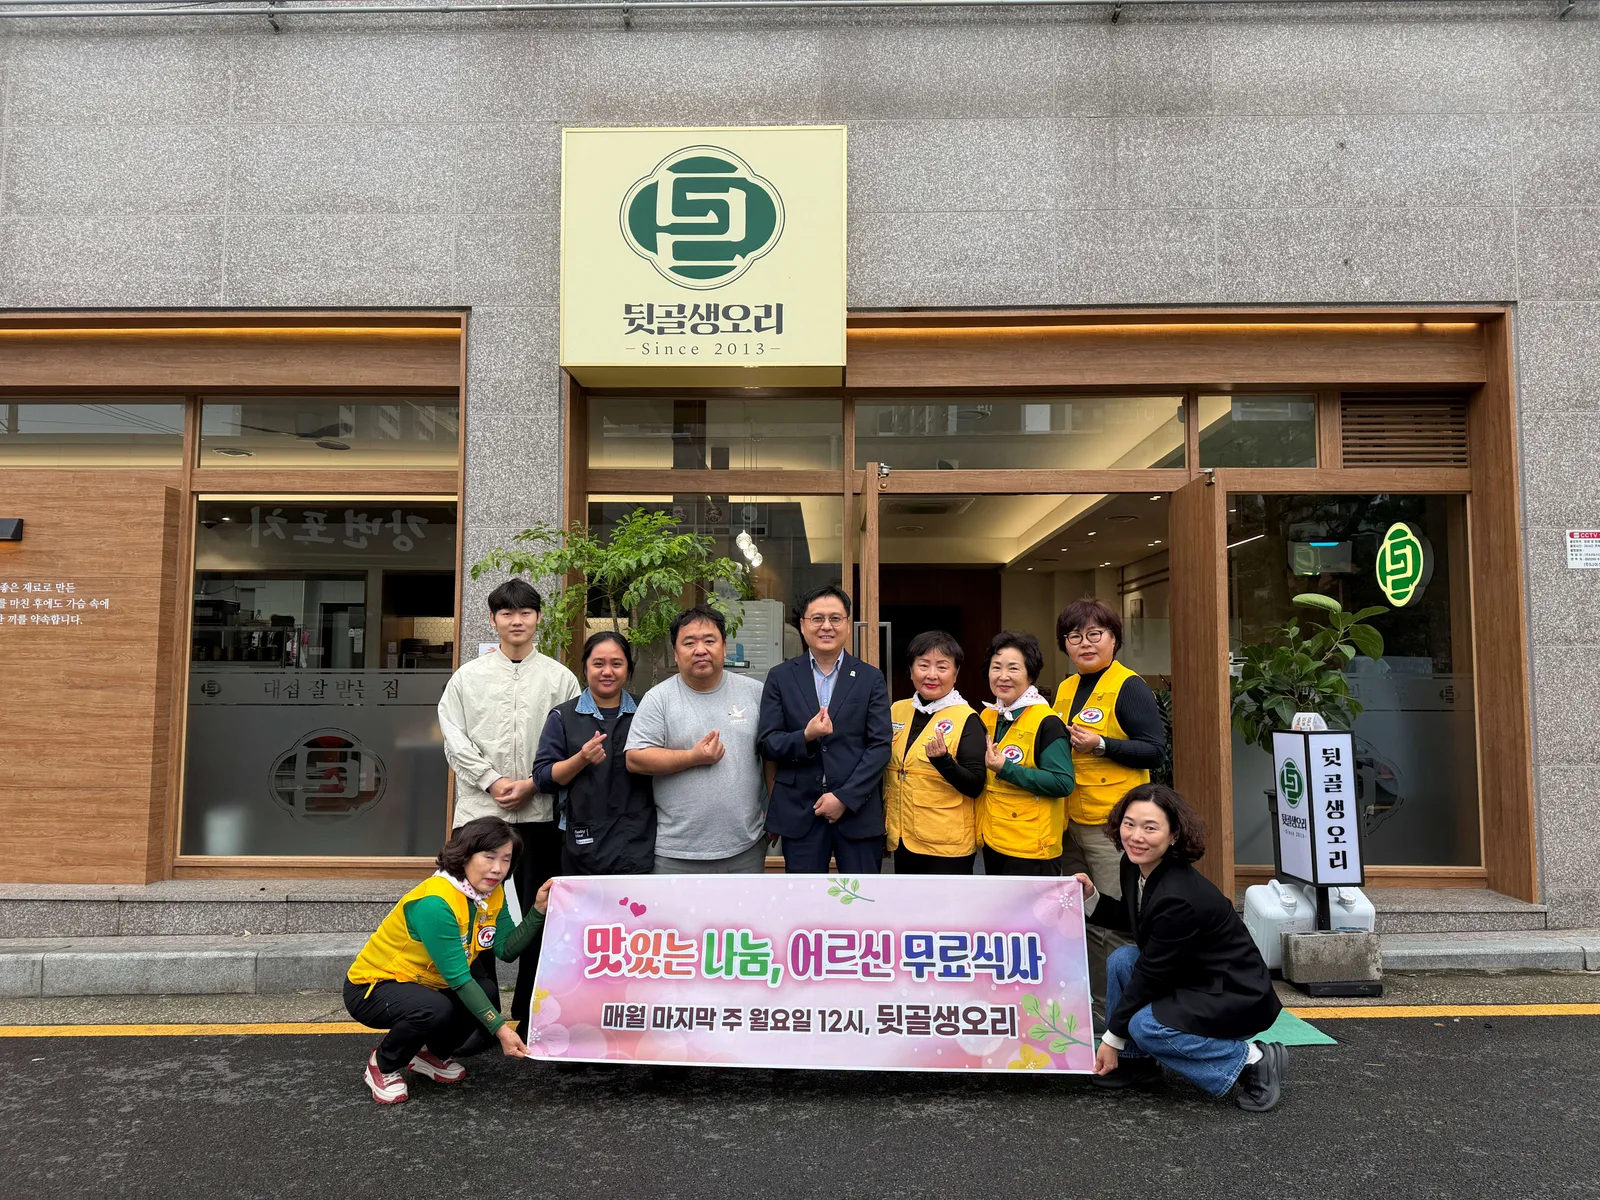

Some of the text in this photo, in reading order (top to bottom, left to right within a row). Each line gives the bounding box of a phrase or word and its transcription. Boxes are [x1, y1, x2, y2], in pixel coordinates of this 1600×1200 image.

[622, 302, 784, 336] 뒷골생오리
[22, 581, 53, 593] 재료로
[55, 582, 76, 593] 만든
[10, 597, 30, 609] 마친
[32, 597, 63, 610] 후에도
[66, 597, 87, 610] 가슴
[89, 597, 110, 610] 속에
[30, 613, 83, 626] 약속합니다.
[308, 678, 328, 700] 잘
[335, 678, 374, 700] 받는
[382, 678, 399, 700] 집
[1321, 747, 1348, 870] 뒷골생오리
[585, 924, 1043, 985] 맛있는 나눔, 어르신 무료식사
[603, 1003, 1017, 1037] 매월 마지막 주 월요일 12시, 뒷골생오리
